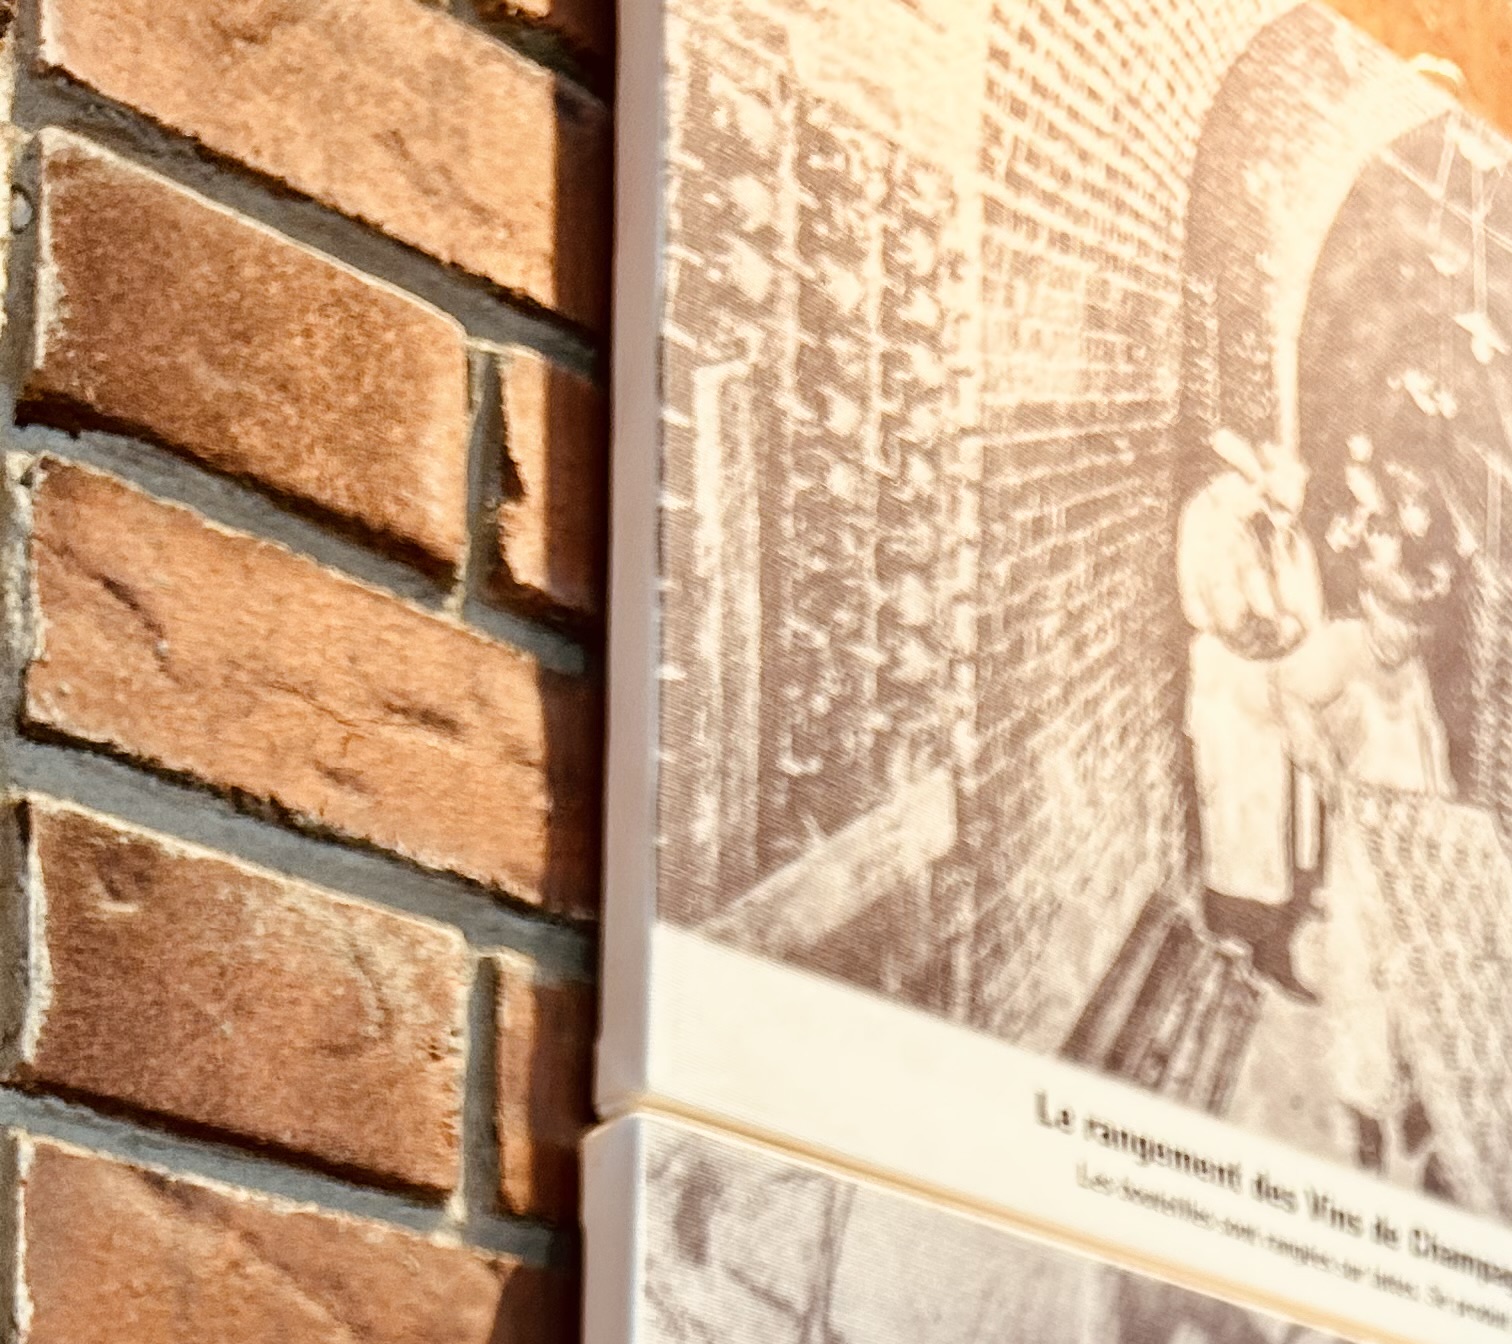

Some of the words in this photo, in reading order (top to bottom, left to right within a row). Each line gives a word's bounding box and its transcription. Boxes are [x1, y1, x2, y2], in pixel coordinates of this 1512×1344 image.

[1033, 1088, 1074, 1134] Le
[1083, 1112, 1244, 1193] rangement
[1252, 1169, 1299, 1213] des
[1306, 1186, 1364, 1237] Vins
[1369, 1214, 1401, 1251] de
